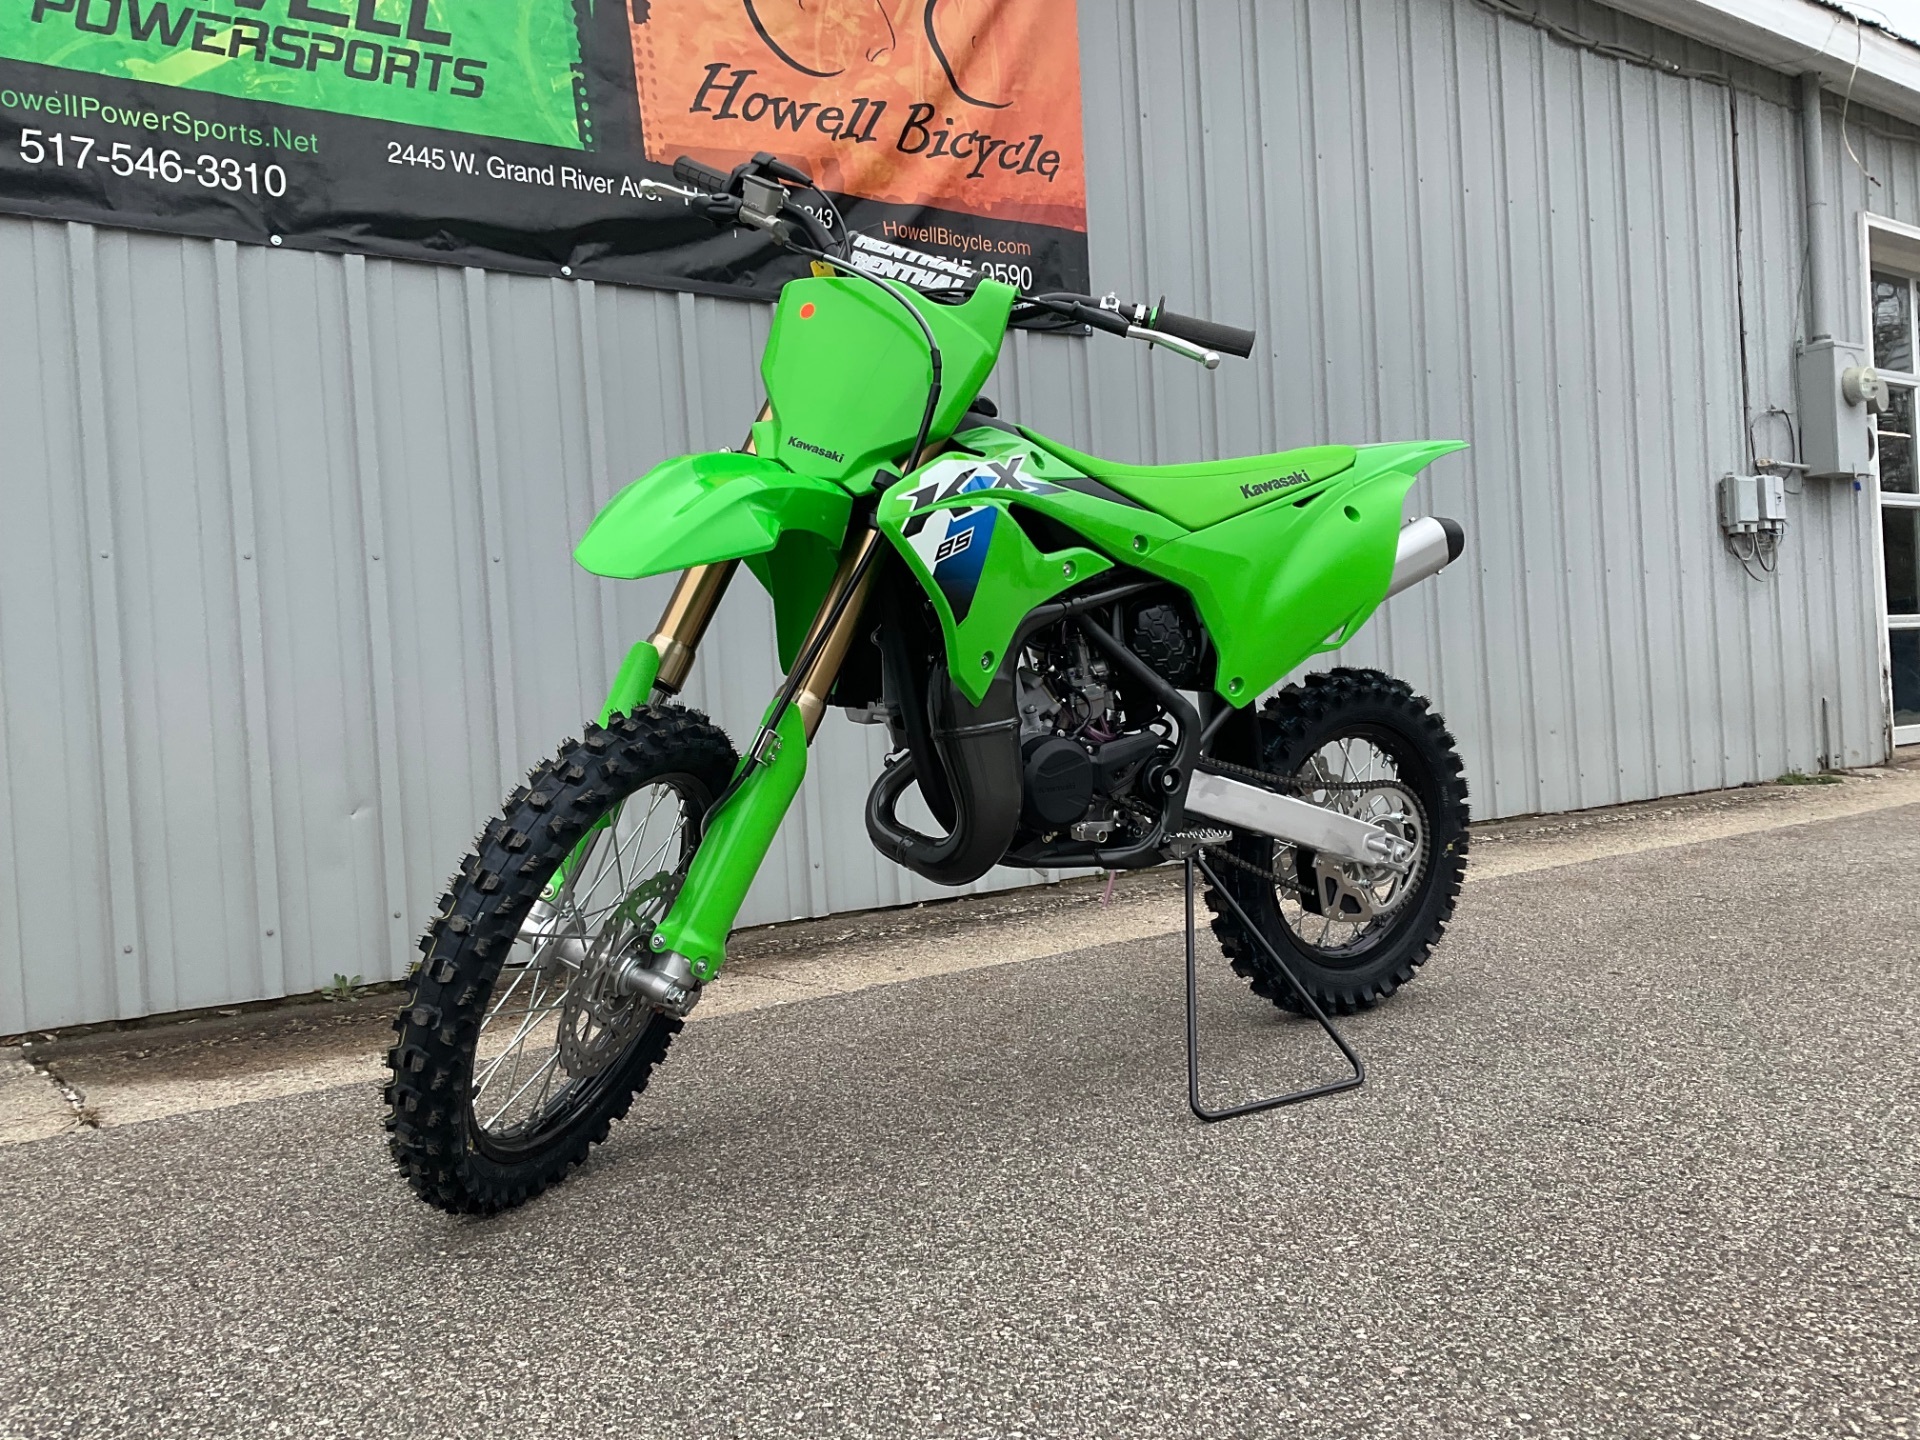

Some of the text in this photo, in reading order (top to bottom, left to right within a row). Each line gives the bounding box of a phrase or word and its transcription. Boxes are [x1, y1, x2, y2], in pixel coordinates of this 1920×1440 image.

[31, 0, 488, 98] POWERSPORTS
[689, 63, 1061, 182] Howell Bicycle
[19, 128, 287, 197] 517-546-3310
[387, 142, 446, 170] 2445
[450, 150, 480, 176] W.
[486, 156, 555, 186] Grand
[561, 166, 615, 195] River
[882, 220, 1032, 256] HowellBicycle.com
[787, 435, 845, 464] Kawasaki
[1239, 469, 1311, 499] Kawasaki
[936, 529, 973, 562] 85
